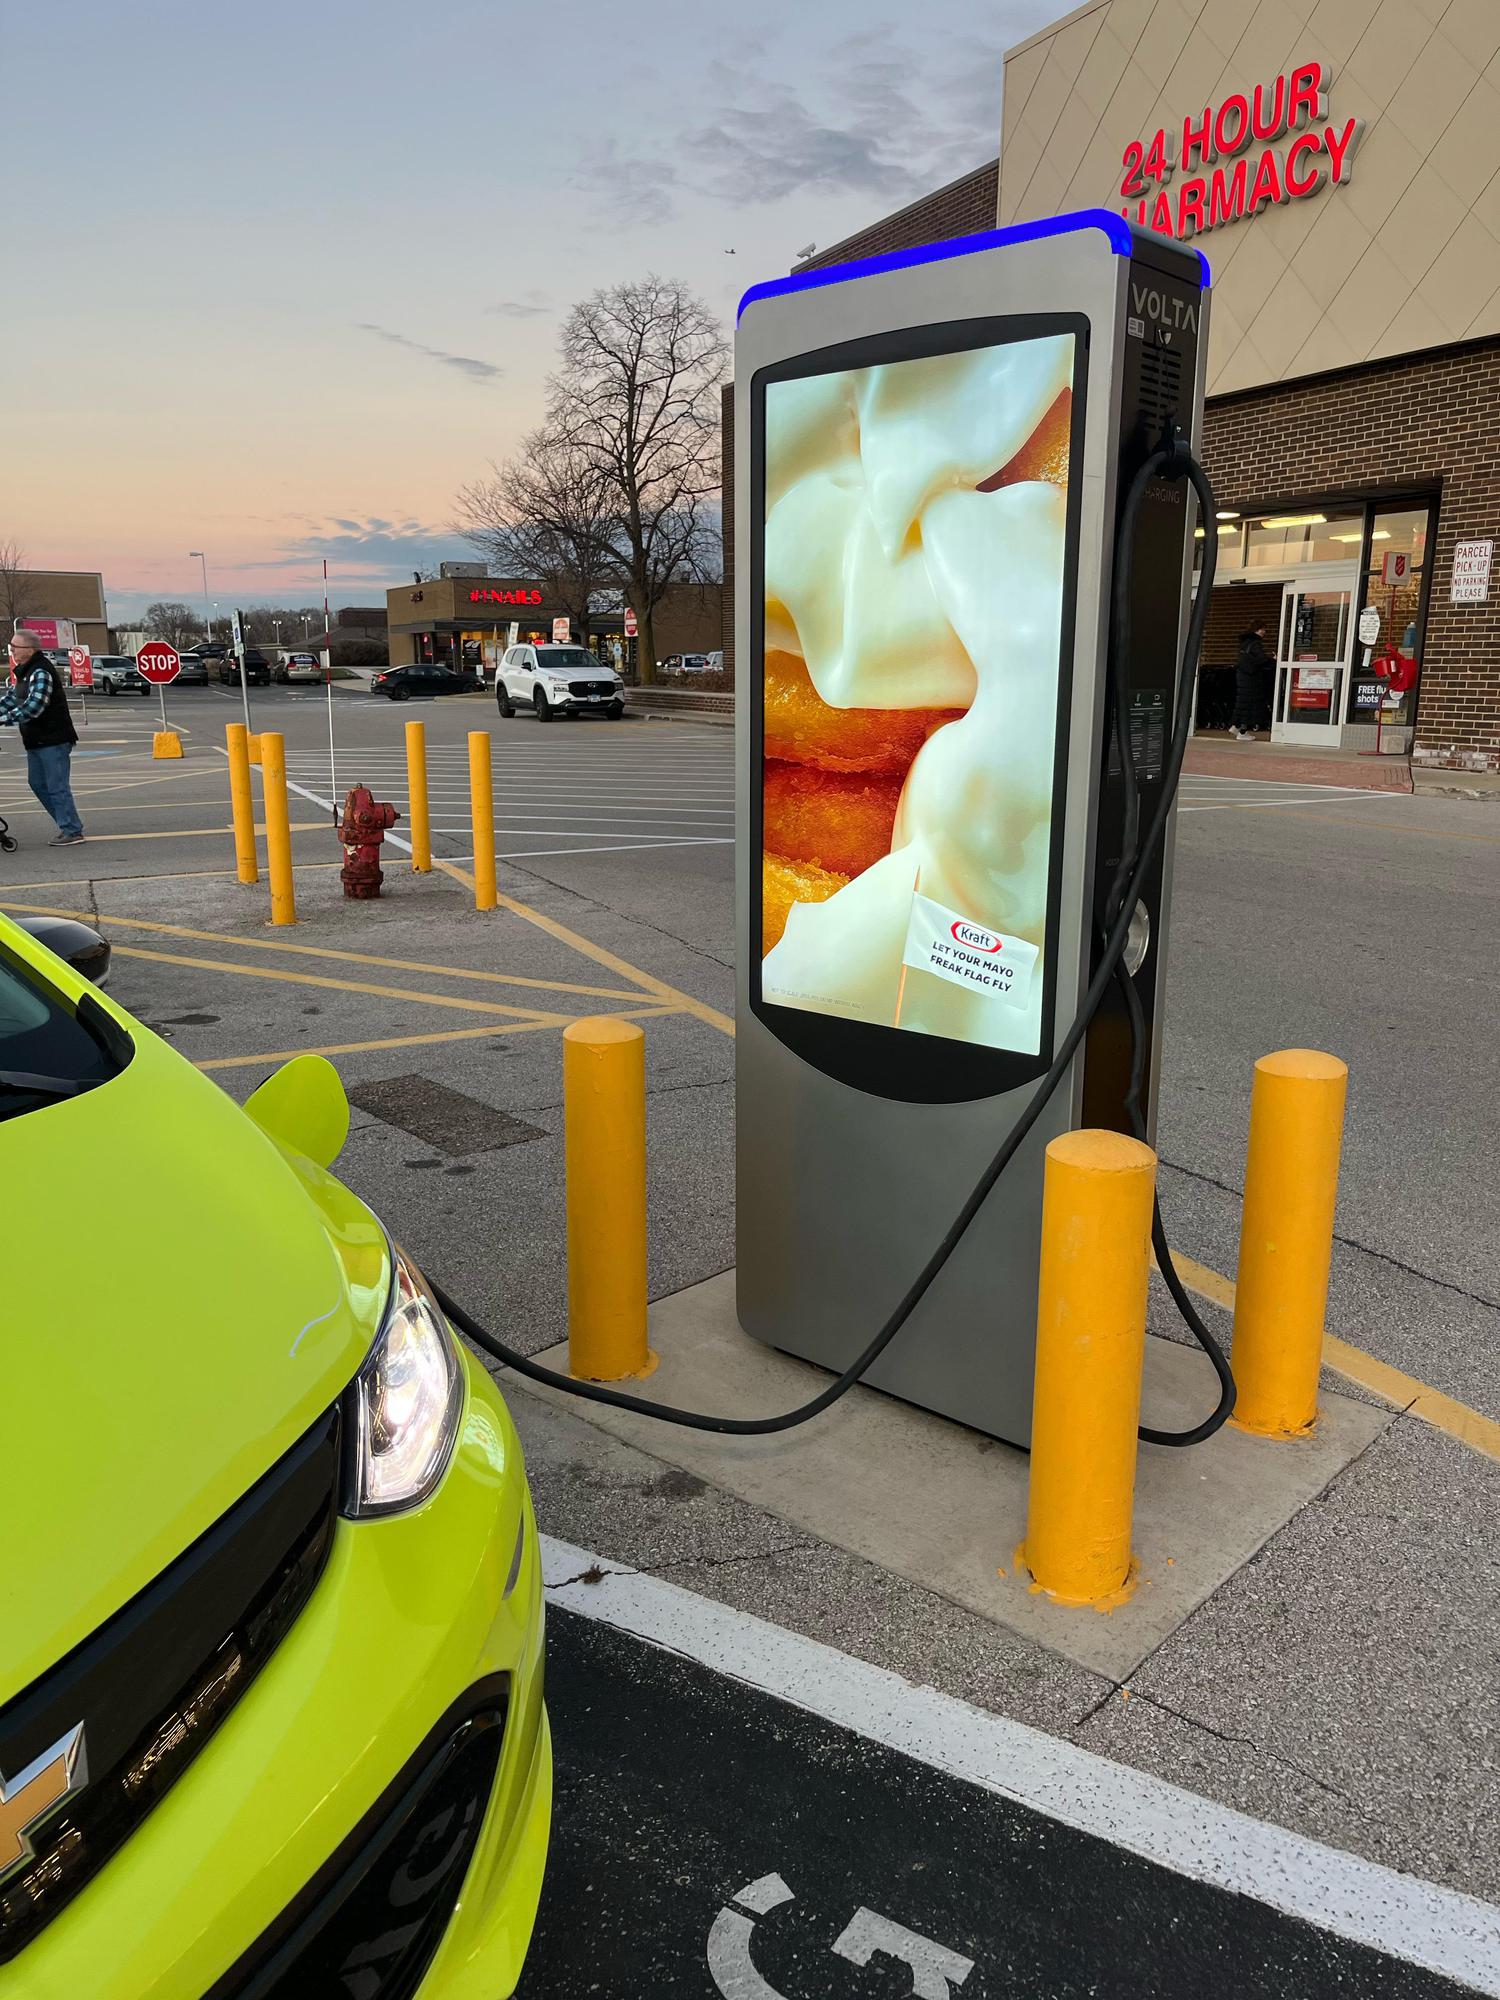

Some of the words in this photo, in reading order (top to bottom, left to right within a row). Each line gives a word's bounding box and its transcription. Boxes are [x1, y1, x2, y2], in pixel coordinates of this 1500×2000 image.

[1120, 128, 1170, 196] 24
[1181, 62, 1323, 173] HOUR
[1121, 117, 1357, 239] ARMACY
[1132, 282, 1197, 335] VOLTA
[1143, 487, 1180, 504] HARGING
[1457, 546, 1489, 558] PARCEL
[1456, 560, 1488, 572] PICK-UP
[1454, 578, 1462, 587] NO
[1462, 577, 1487, 586] PARKING
[470, 589, 488, 604] #1
[491, 589, 544, 605] NAILS
[1455, 588, 1482, 598] PLEASE
[139, 654, 177, 671] STOP
[1357, 685, 1376, 694] FREE
[1376, 685, 1387, 694] flu
[1357, 694, 1379, 703] shots
[960, 926, 991, 948] Kraft
[932, 941, 951, 954] LET
[953, 949, 981, 967] YOUR
[982, 960, 1014, 978] MAYO
[930, 955, 962, 975] FREAK
[964, 969, 991, 985] FLAG
[992, 979, 1012, 992] FLY
